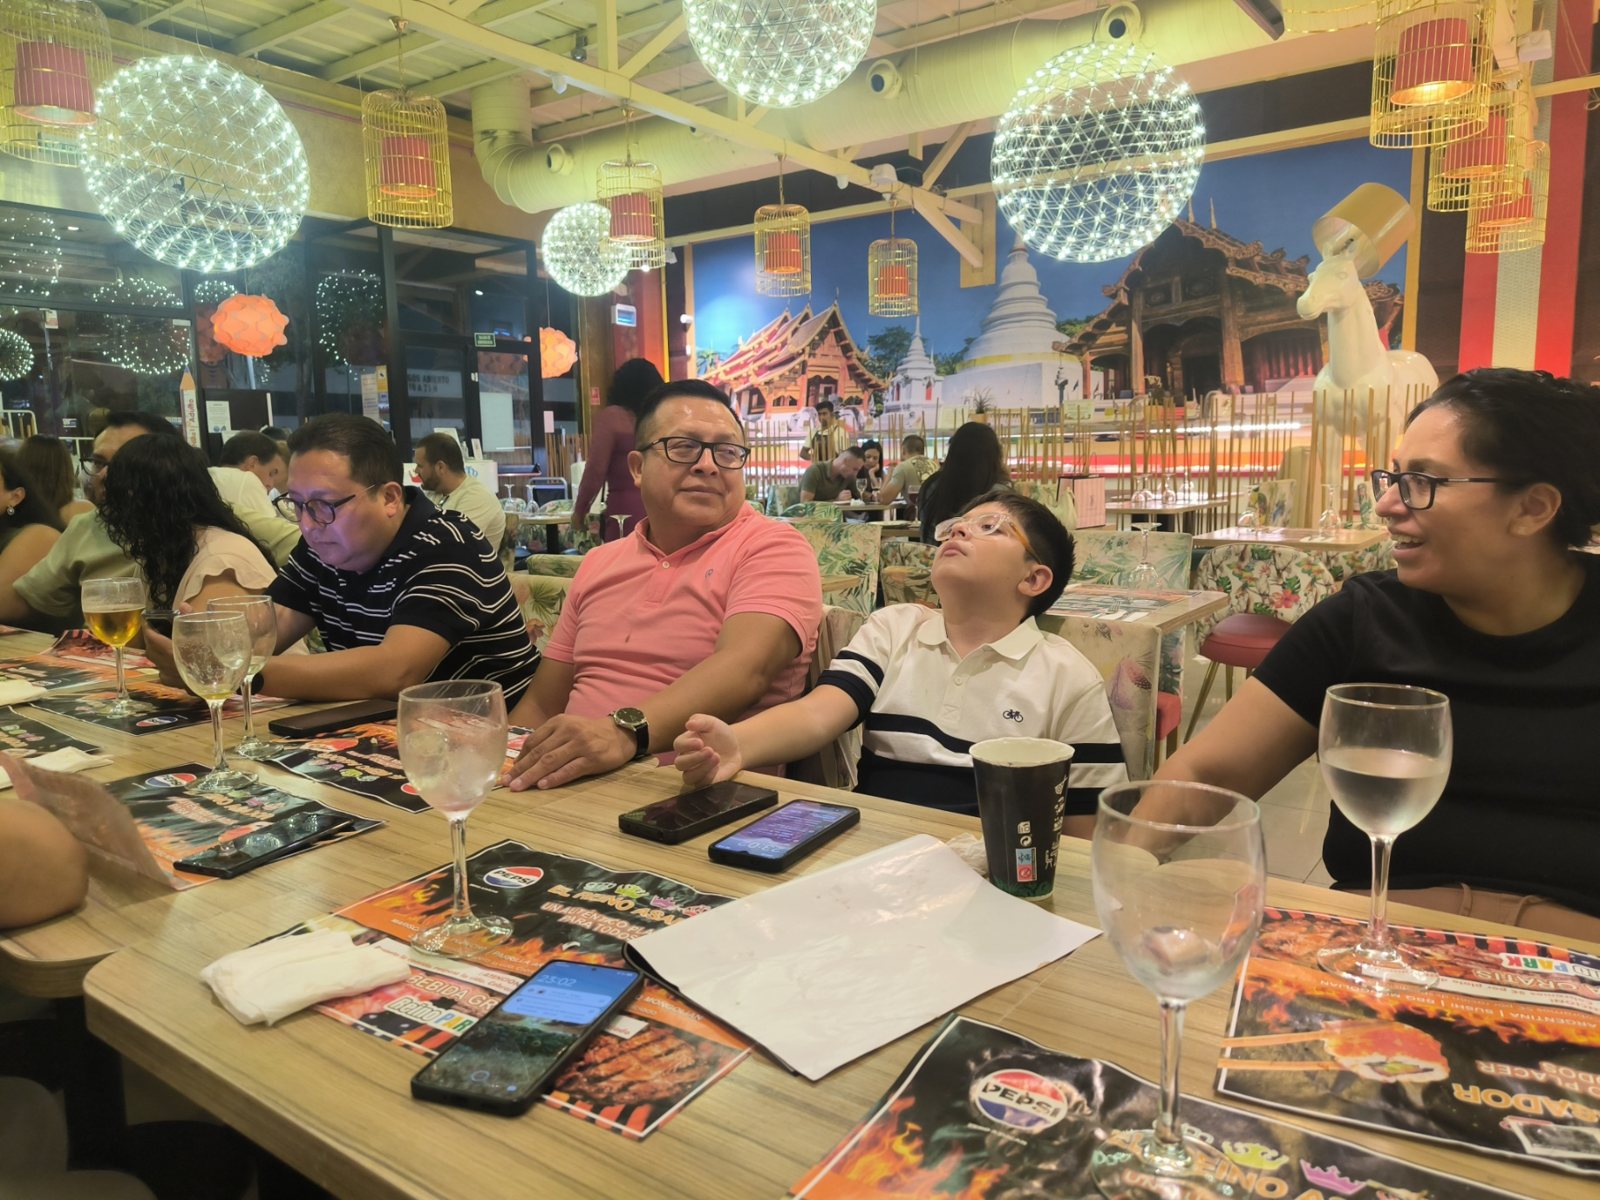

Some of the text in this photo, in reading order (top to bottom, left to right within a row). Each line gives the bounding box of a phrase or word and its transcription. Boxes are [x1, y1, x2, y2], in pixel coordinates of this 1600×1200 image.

[493, 869, 533, 885] PEPSI
[541, 901, 565, 915] UN
[558, 914, 593, 930] PARA
[1507, 956, 1569, 973] PARK
[406, 973, 469, 1002] BEBIDA
[537, 974, 577, 988] 23:02
[1509, 1012, 1597, 1029] ARGENTINA
[1475, 1060, 1580, 1092] PLACER
[982, 1082, 1062, 1119] PEPSI
